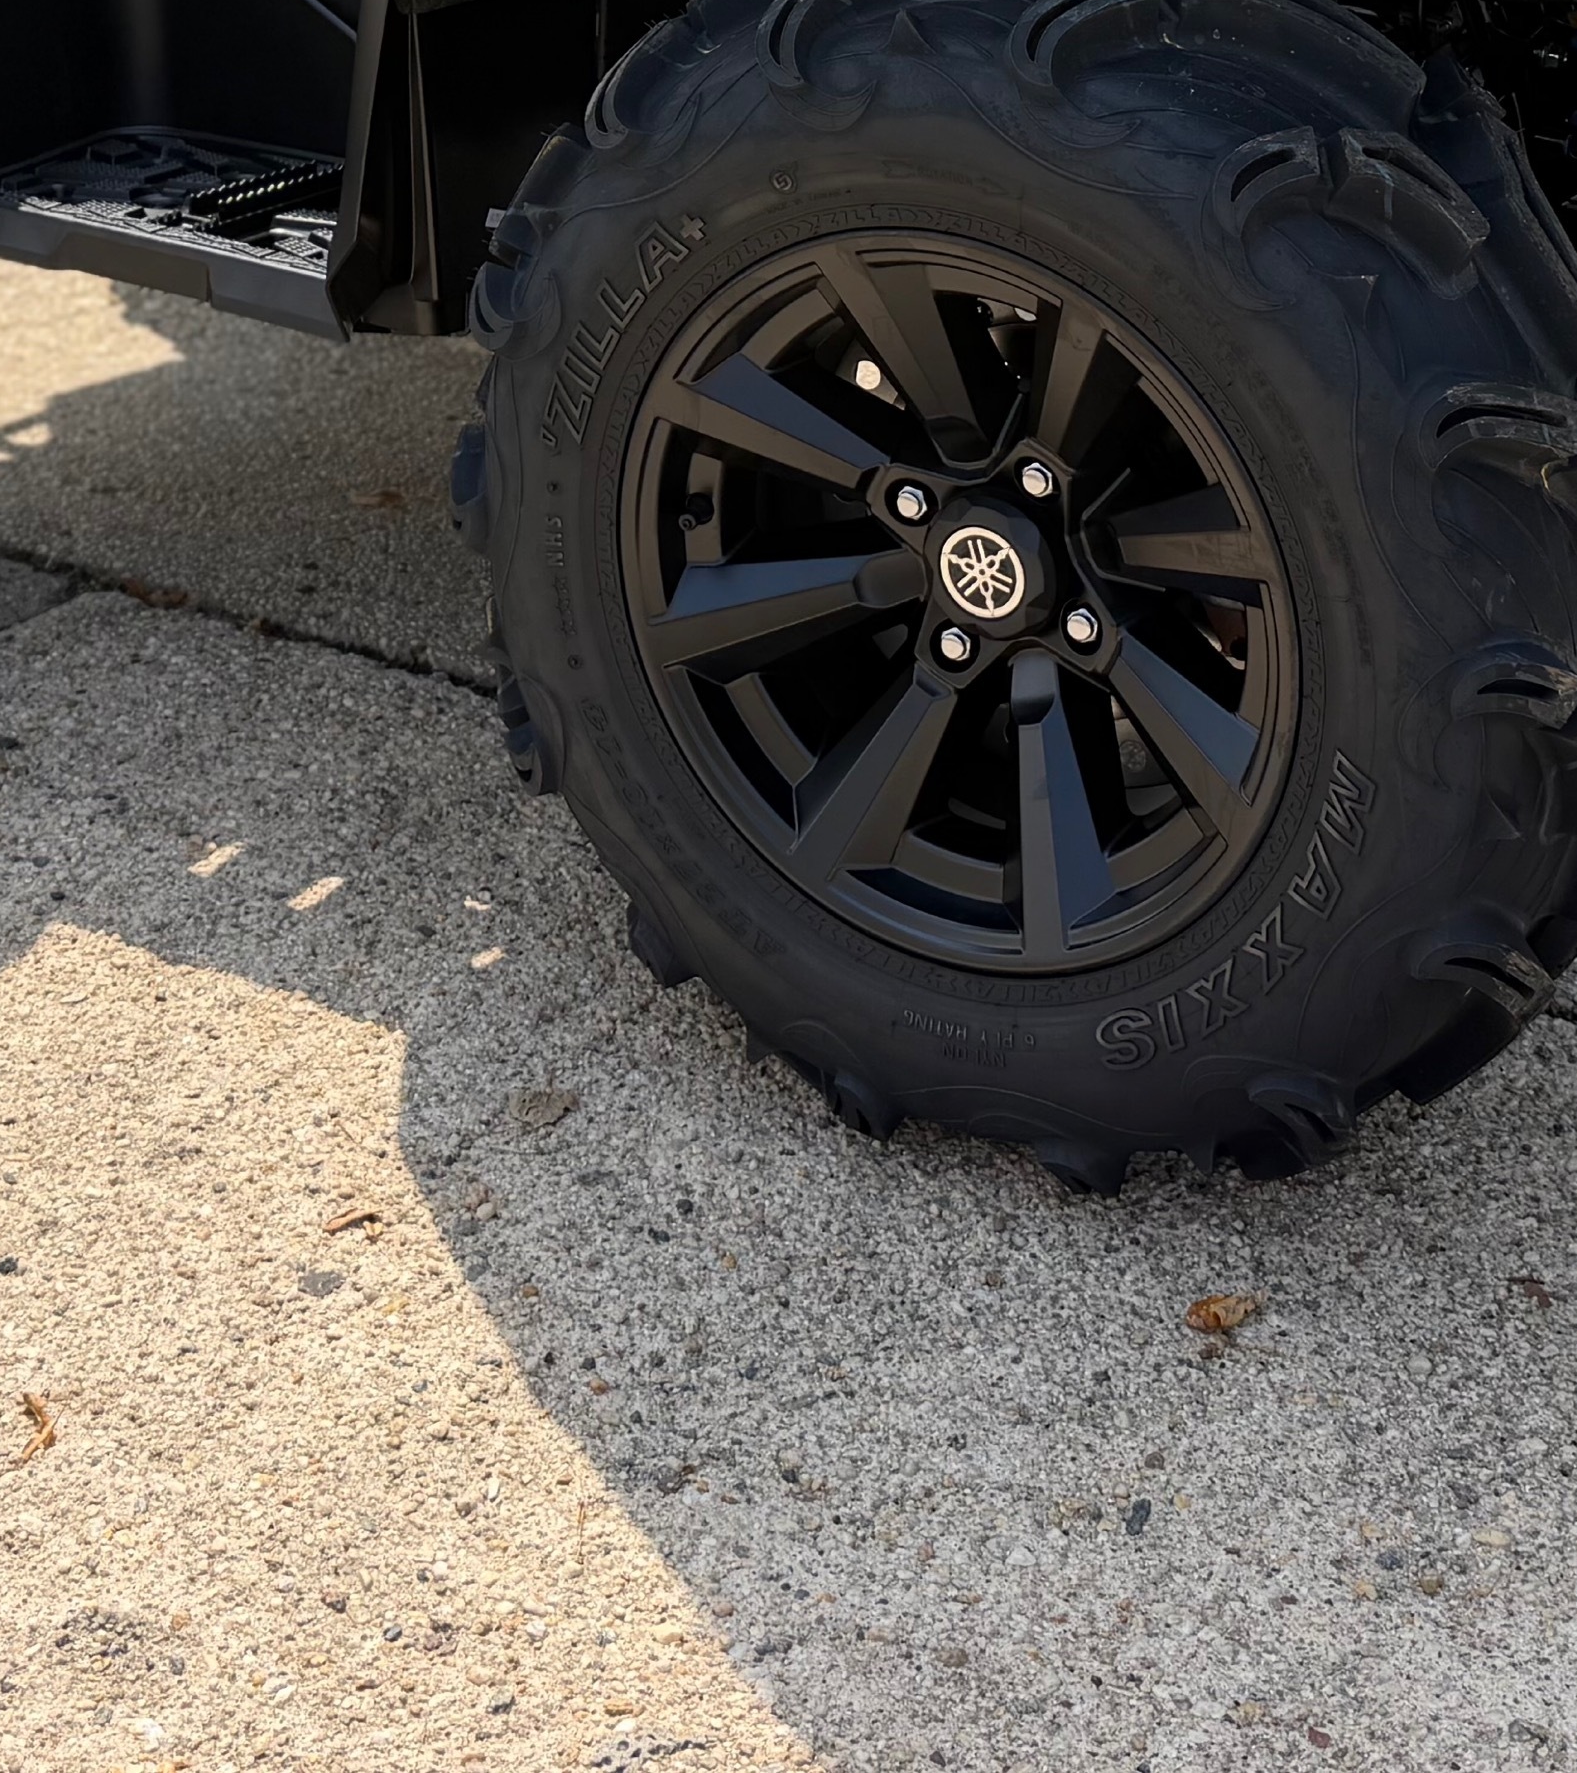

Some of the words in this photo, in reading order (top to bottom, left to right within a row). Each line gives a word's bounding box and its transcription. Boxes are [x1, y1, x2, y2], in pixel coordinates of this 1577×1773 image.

[544, 515, 565, 568] NHS
[1094, 748, 1377, 1071] MAXXIS
[903, 1009, 969, 1043] RATING
